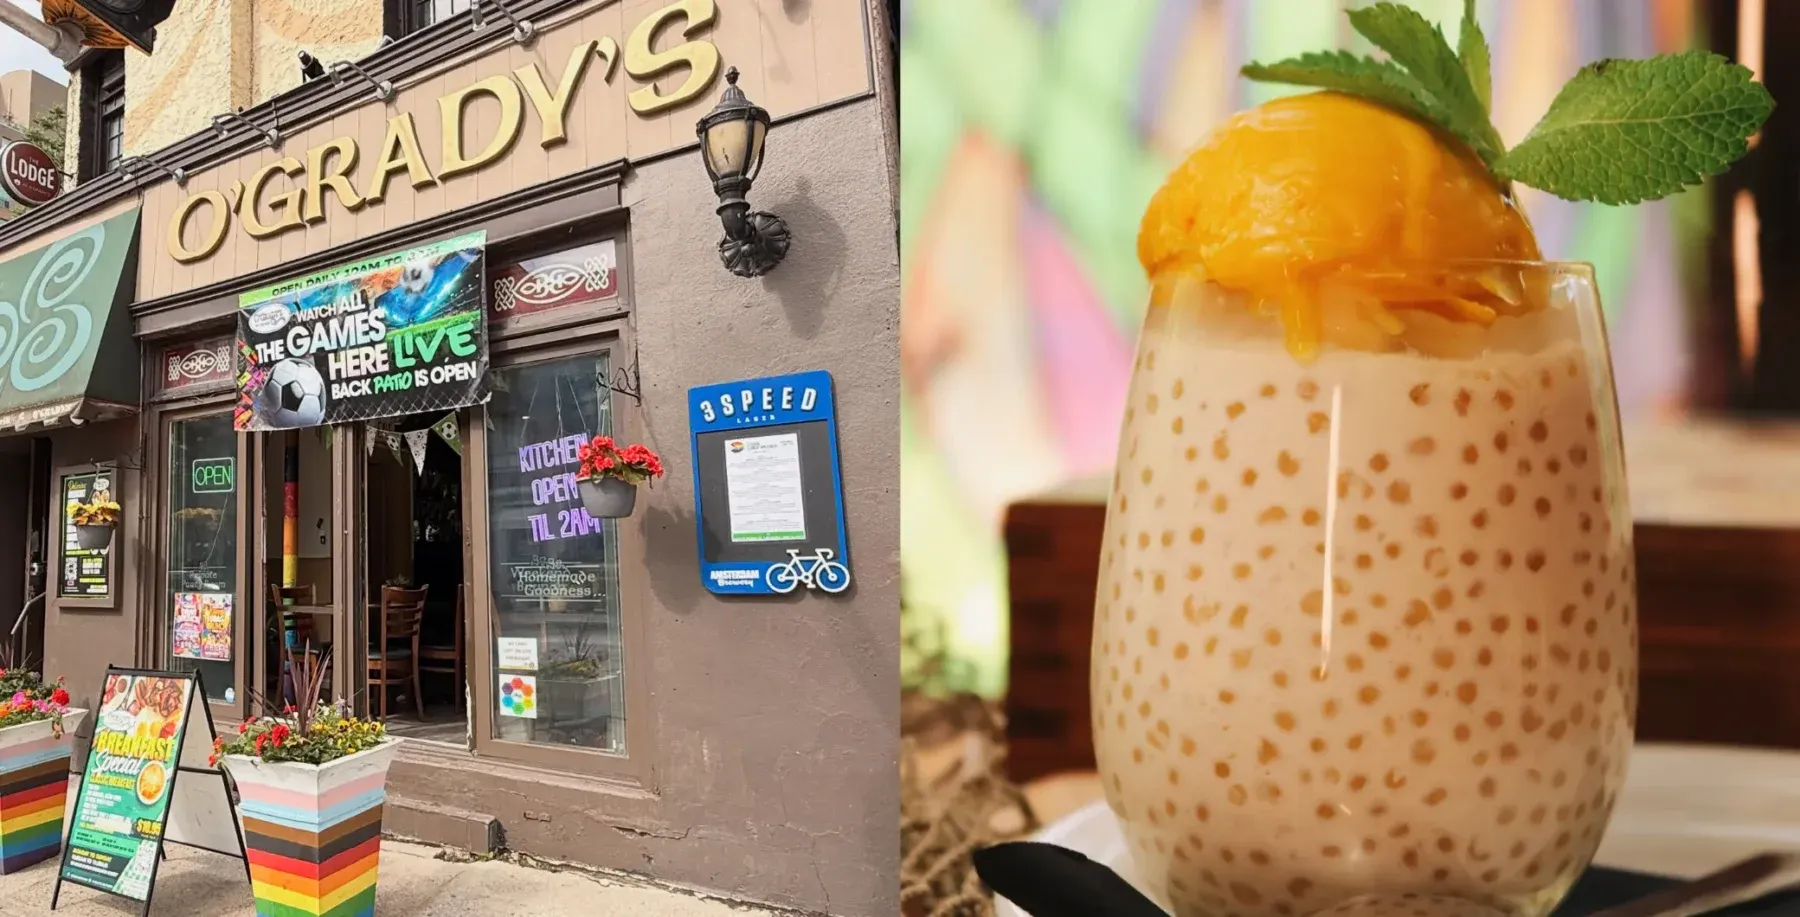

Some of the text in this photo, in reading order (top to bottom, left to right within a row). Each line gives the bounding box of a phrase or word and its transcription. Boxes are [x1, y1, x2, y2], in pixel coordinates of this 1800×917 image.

[167, 0, 721, 263] O'GRADY'S
[11, 150, 55, 190] LODGE
[272, 282, 303, 297] OPEN
[306, 271, 340, 287] DAILY
[385, 256, 402, 268] TO
[296, 292, 366, 323] WATCH ALL
[255, 308, 387, 364] THE GAMES
[328, 322, 477, 381] HERE LIVE
[331, 360, 477, 400] BACK PATIO IS OPEN
[737, 414, 775, 424] LAGER
[518, 432, 589, 473] KITCHEN
[195, 465, 232, 486] OPEN
[531, 472, 580, 506] OPEN
[528, 506, 601, 543] TIL 2AM
[519, 570, 596, 584] Homemade
[710, 570, 760, 580] AMSTERDAM
[91, 749, 146, 776] Special
[96, 731, 174, 762] BREAKFAST
